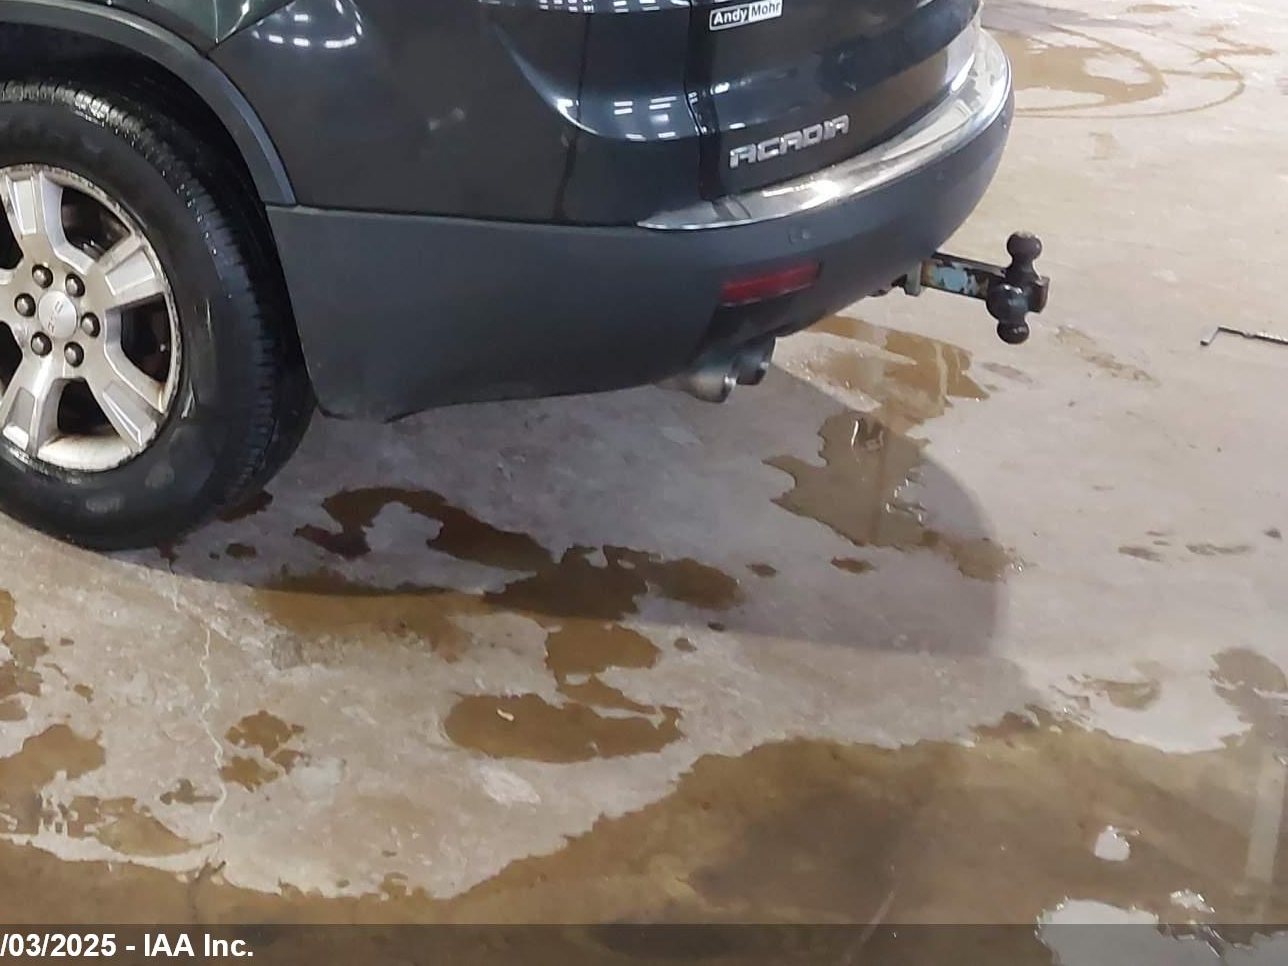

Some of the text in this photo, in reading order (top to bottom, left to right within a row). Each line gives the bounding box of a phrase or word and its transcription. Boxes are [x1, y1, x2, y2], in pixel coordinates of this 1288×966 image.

[713, 0, 782, 27] Andy Mohr
[729, 114, 850, 169] ACADIA
